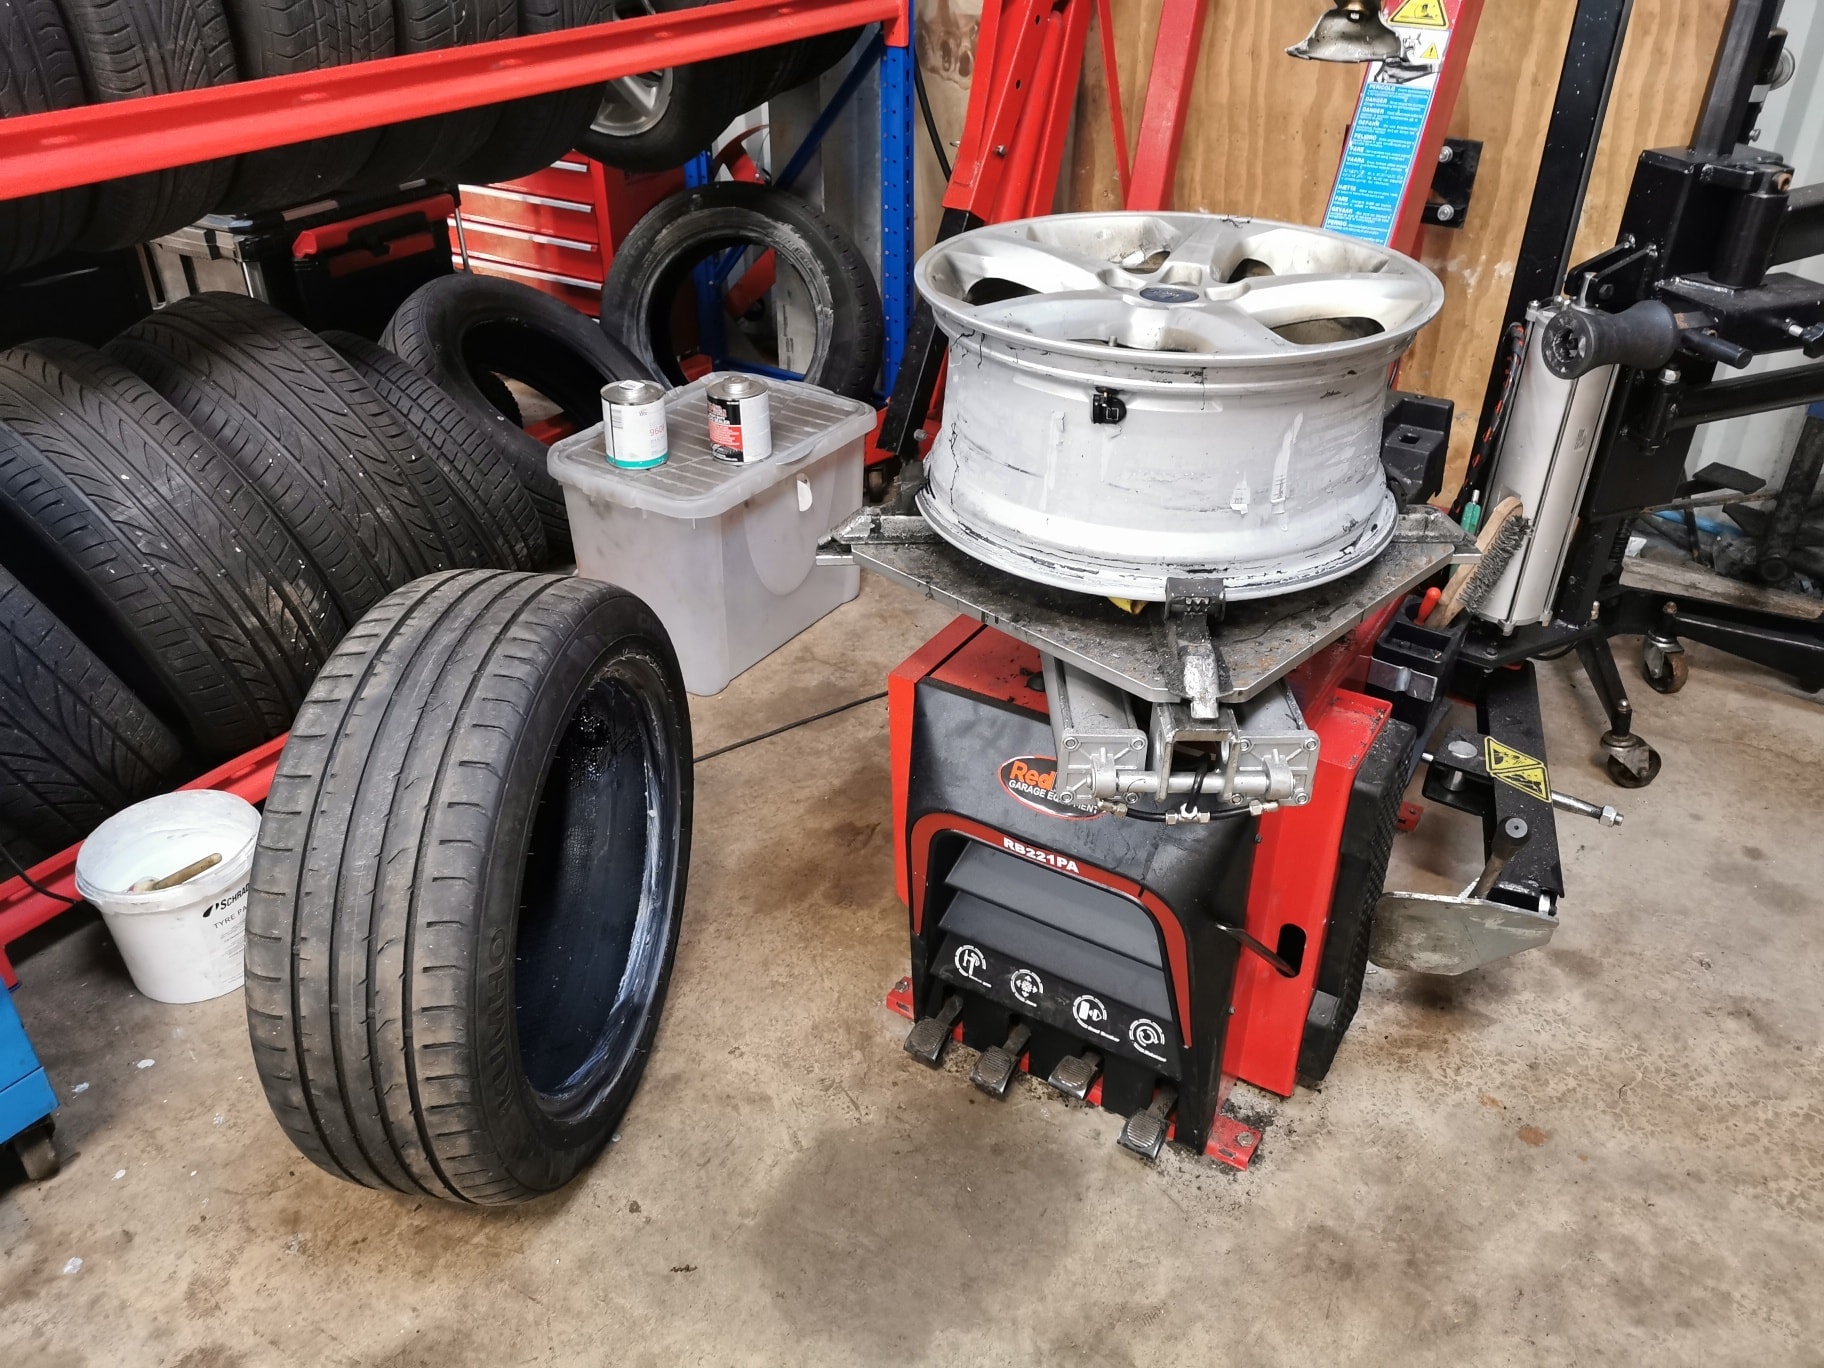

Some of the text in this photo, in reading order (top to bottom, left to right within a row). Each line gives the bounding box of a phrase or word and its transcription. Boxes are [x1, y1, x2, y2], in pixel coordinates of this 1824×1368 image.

[1368, 84, 1396, 92] PERICOLO
[1365, 96, 1388, 105] DANGER
[1008, 779, 1046, 798] GARAGE
[1003, 837, 1080, 874] RB221PA
[213, 913, 237, 929] TYRE
[488, 928, 514, 1113] KUMHO
